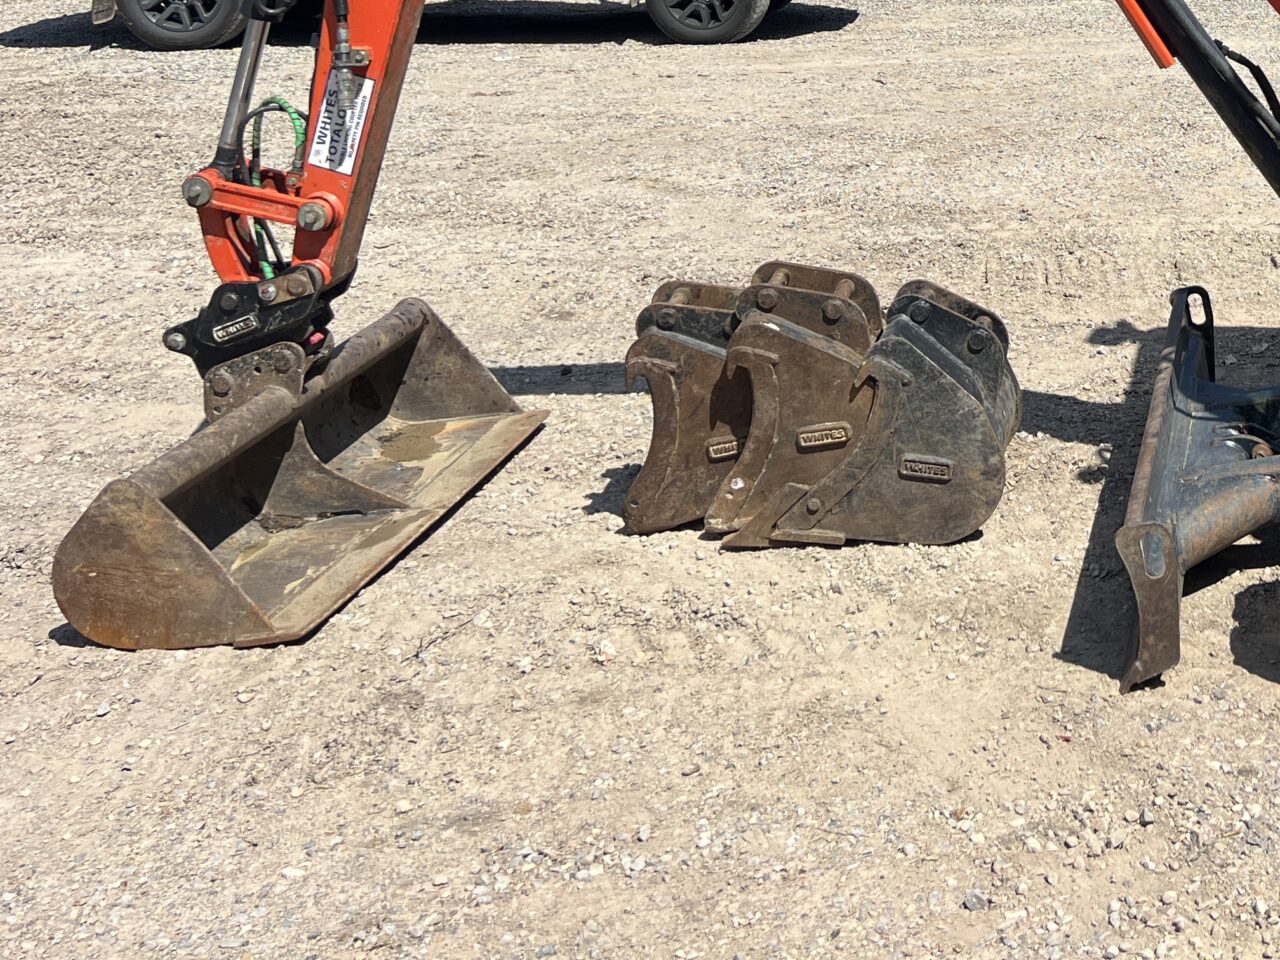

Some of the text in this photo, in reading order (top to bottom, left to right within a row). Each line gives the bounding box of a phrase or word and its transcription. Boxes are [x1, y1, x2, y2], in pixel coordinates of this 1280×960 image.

[315, 88, 339, 146] WHITES
[324, 107, 347, 165] TOTALO
[801, 428, 846, 445] WHITES
[903, 461, 949, 477] WHITES
